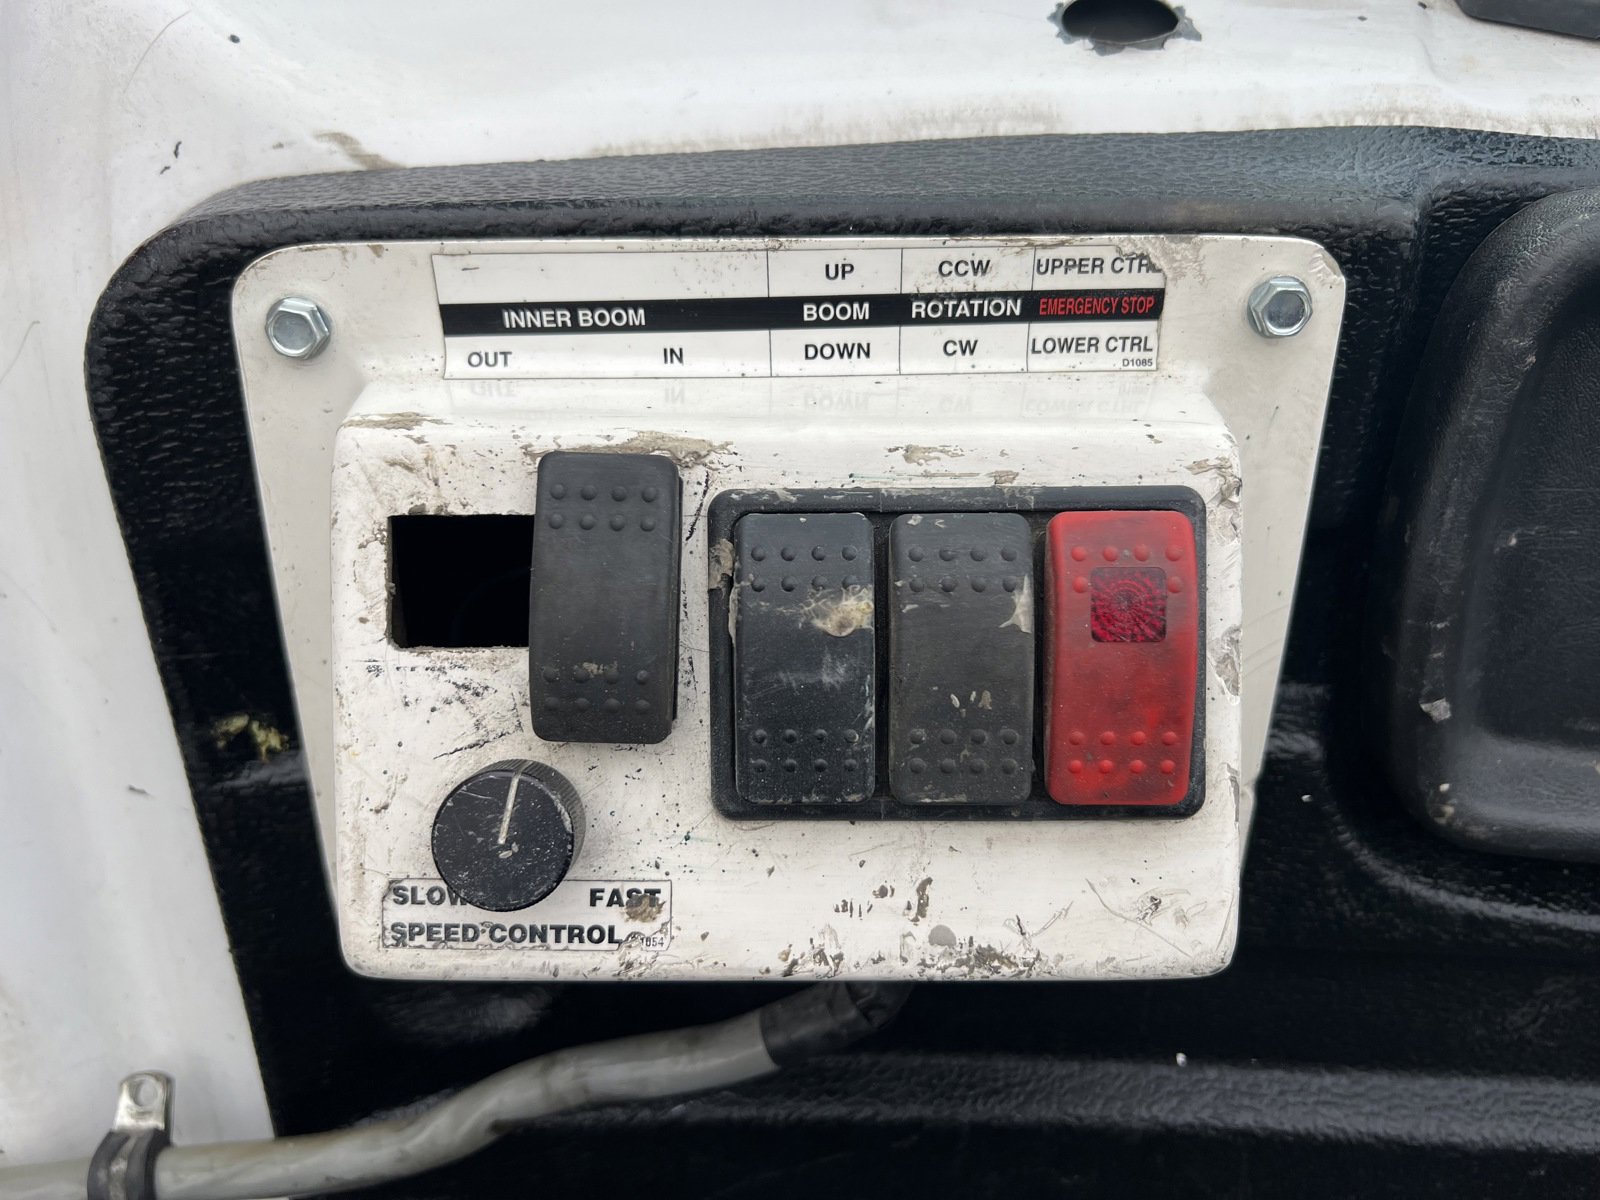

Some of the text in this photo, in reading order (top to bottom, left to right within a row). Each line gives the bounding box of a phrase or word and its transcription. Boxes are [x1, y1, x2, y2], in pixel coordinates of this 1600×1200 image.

[824, 263, 855, 280] UP
[937, 259, 991, 277] CCW
[1035, 257, 1105, 275] UPPER
[803, 302, 870, 321] BOOM
[911, 299, 1022, 319] ROTATION
[1039, 295, 1155, 316] EMERGENCY STOP
[504, 307, 646, 328] INNER BOOM
[804, 343, 871, 360] DOWN
[942, 340, 978, 356] CW
[1031, 336, 1154, 356] LOWER CTRL
[467, 351, 513, 368] OUT
[663, 348, 684, 364] IN
[1121, 358, 1153, 368] D1085
[589, 887, 662, 907] FAST
[390, 921, 623, 944] SPEED CONTROL
